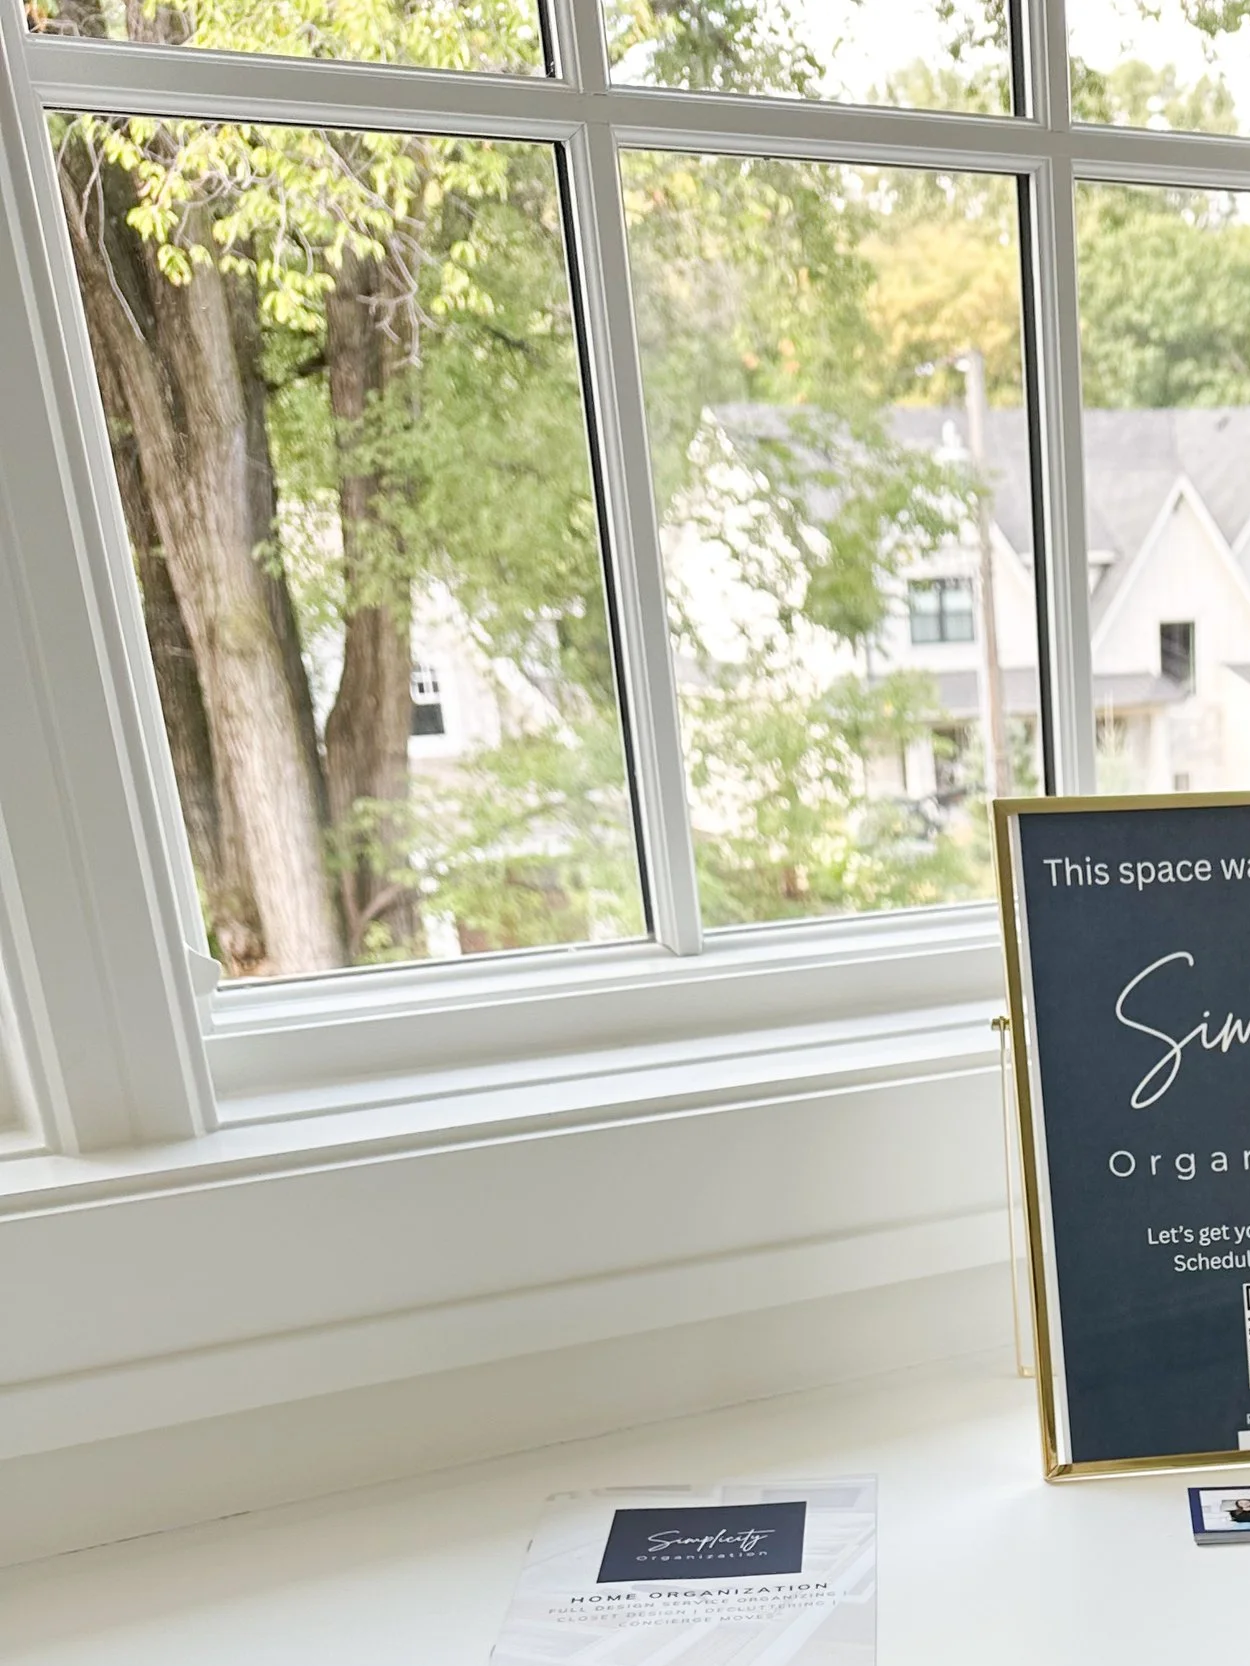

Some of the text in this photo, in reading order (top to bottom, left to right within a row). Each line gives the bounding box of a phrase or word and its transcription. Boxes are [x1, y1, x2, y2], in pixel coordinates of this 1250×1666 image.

[1043, 856, 1110, 888] This
[1118, 859, 1212, 892] space
[1198, 1224, 1232, 1247] get
[647, 1528, 776, 1552] Simplicity
[571, 1582, 828, 1604] HOME ORGANIZATION
[595, 1602, 654, 1612] DESIGN
